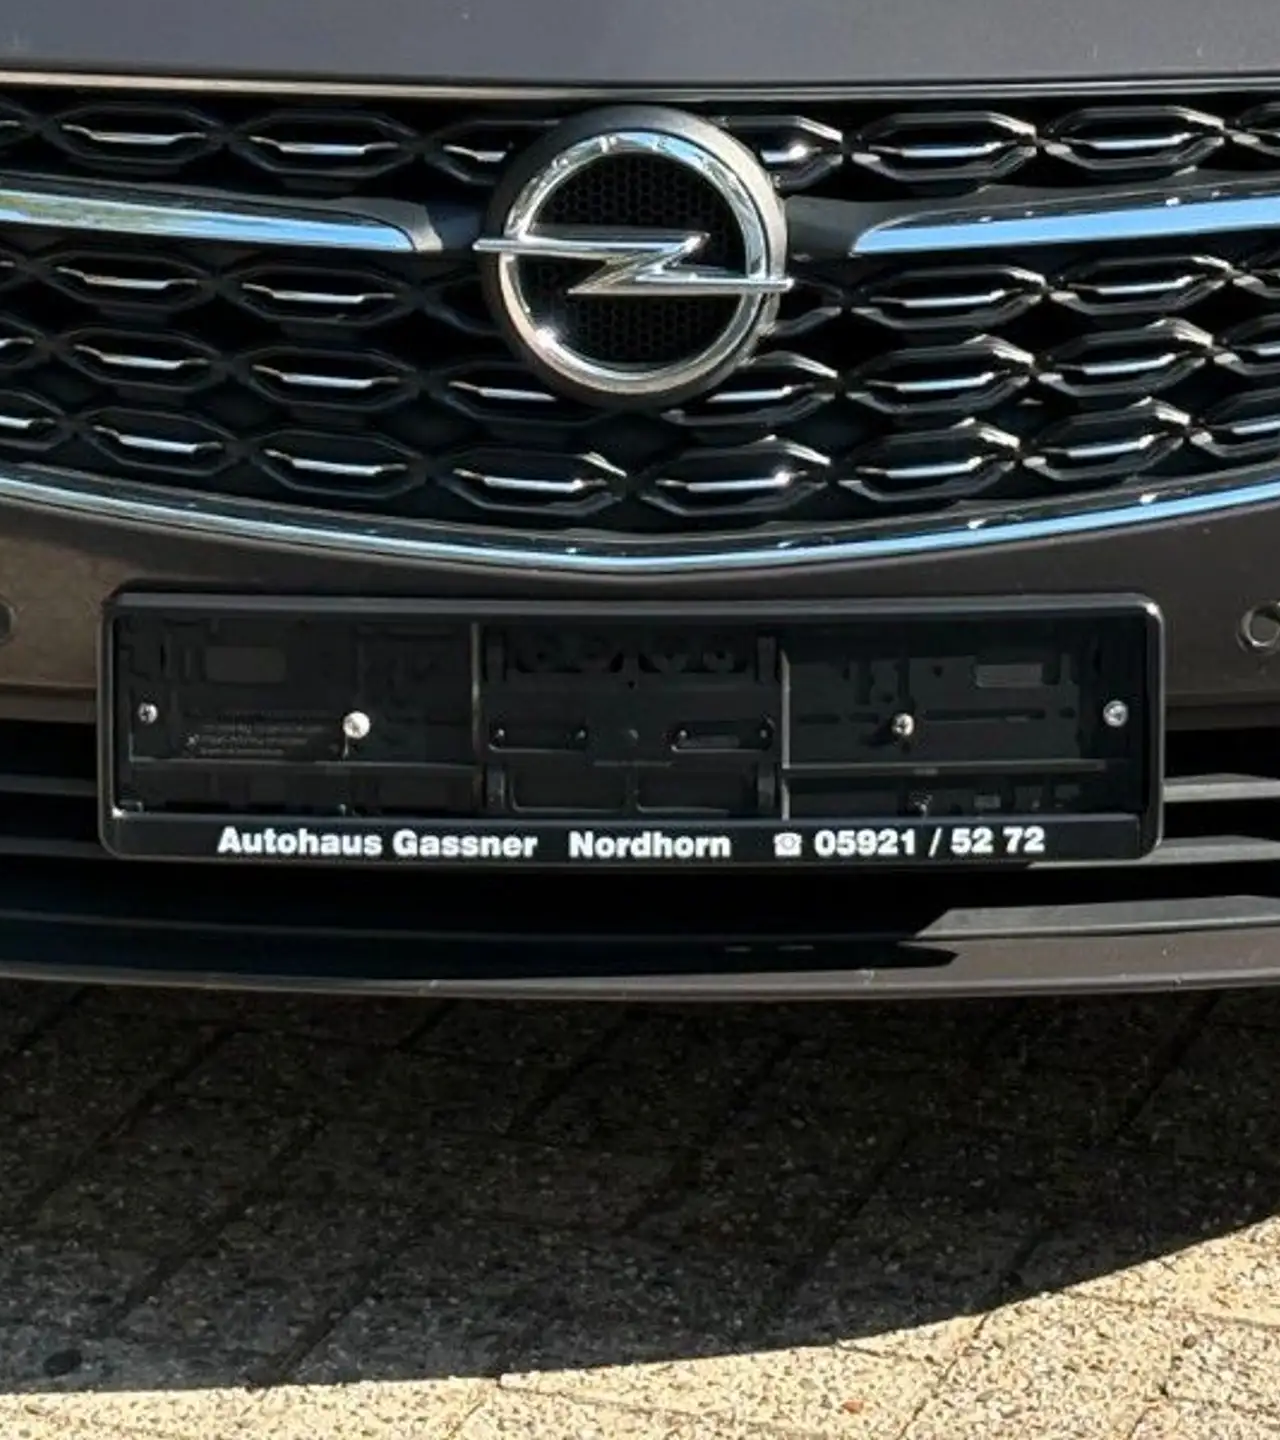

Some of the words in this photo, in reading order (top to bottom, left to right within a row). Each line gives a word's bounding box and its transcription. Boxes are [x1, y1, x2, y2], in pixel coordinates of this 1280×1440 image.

[218, 827, 383, 856] Autohaus
[392, 829, 539, 857] Gassner
[568, 831, 731, 858] Nordhorn
[815, 829, 917, 856] 05921
[950, 827, 996, 855] 52
[1003, 826, 1046, 853] 72
